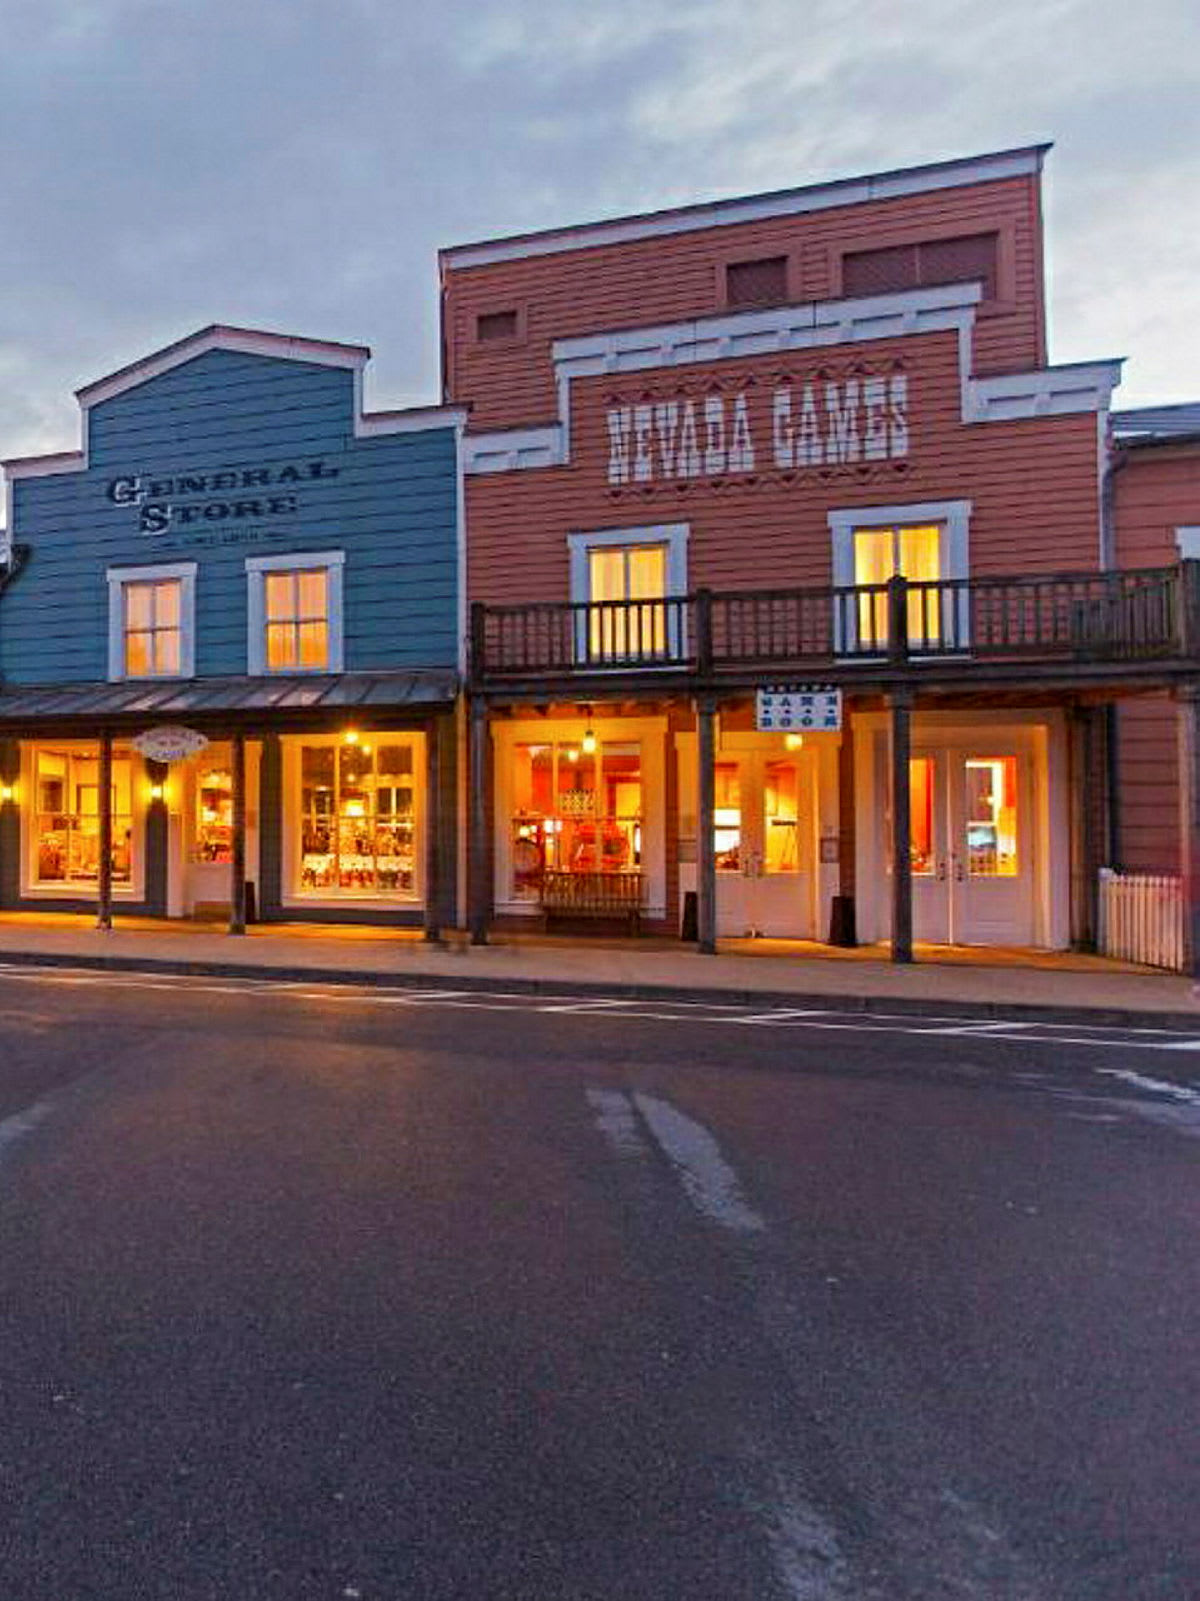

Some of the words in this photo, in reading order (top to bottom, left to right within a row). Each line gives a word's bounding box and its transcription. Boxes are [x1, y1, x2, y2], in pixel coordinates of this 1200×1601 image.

[607, 393, 755, 484] NEVADA
[773, 375, 909, 468] GAMES
[108, 461, 340, 507] GENERAL
[138, 496, 298, 535] STORE
